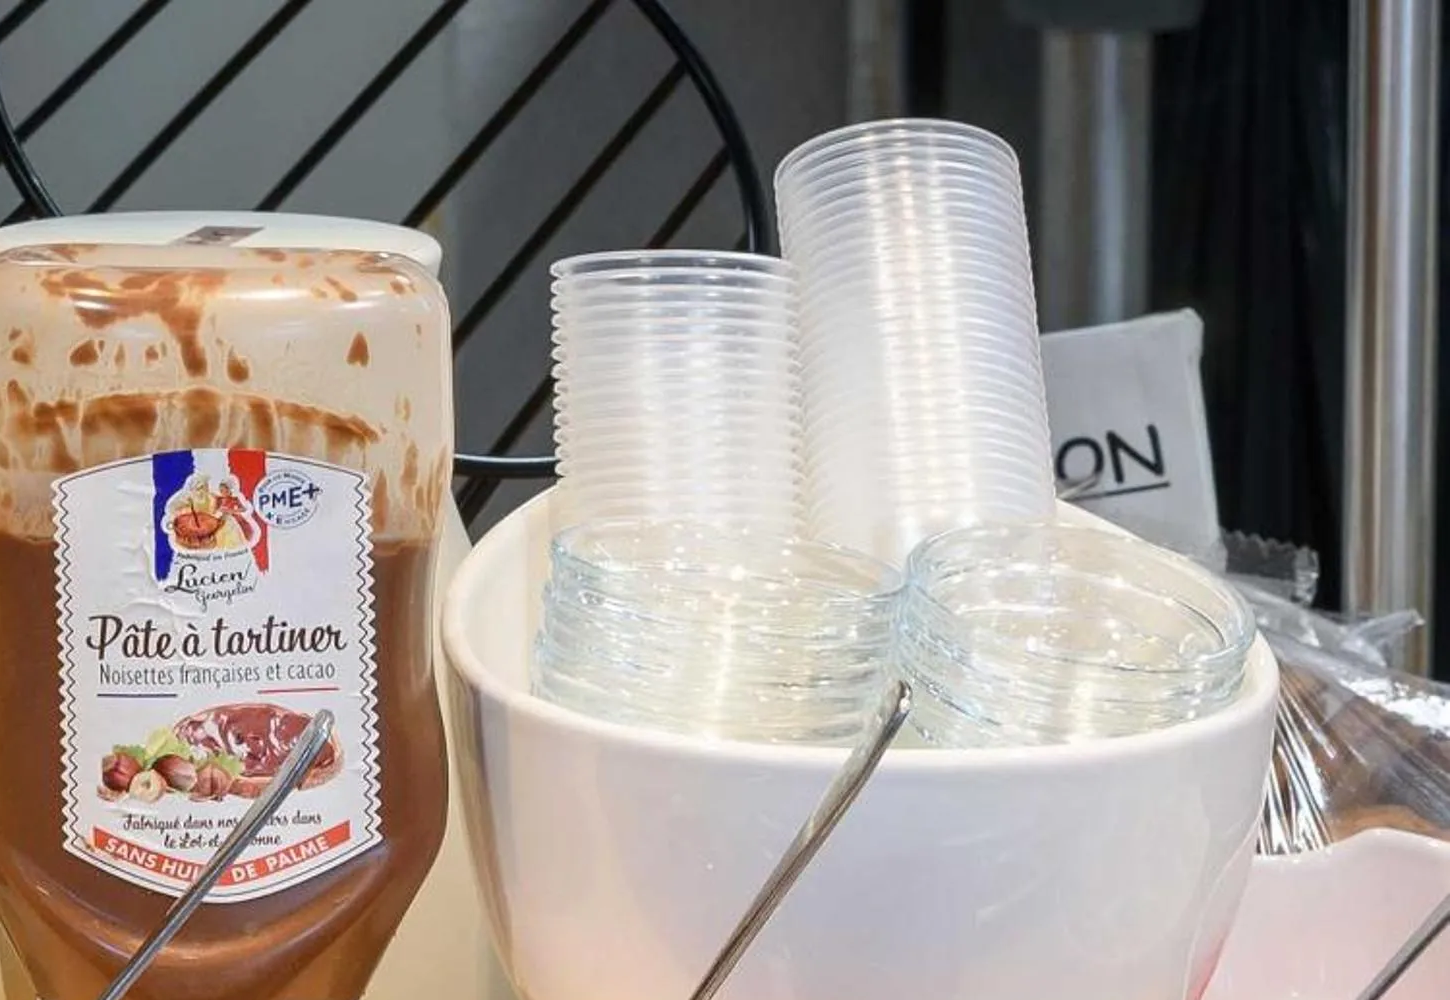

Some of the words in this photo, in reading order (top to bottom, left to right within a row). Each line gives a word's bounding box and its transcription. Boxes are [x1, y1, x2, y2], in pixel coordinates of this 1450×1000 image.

[1055, 423, 1165, 487] ON
[258, 482, 320, 511] PME+
[164, 558, 252, 594] Lucien
[86, 615, 177, 661] Pâte
[182, 623, 202, 654] à
[210, 615, 347, 653] tartiner
[99, 663, 174, 686] Noisettes
[179, 662, 261, 690] françaises
[265, 661, 282, 682] et
[287, 663, 336, 682] cacao
[183, 812, 214, 829] dans
[292, 809, 322, 824] dans
[105, 837, 157, 869] SANS
[231, 865, 258, 883] DE
[265, 835, 329, 871] PALME
